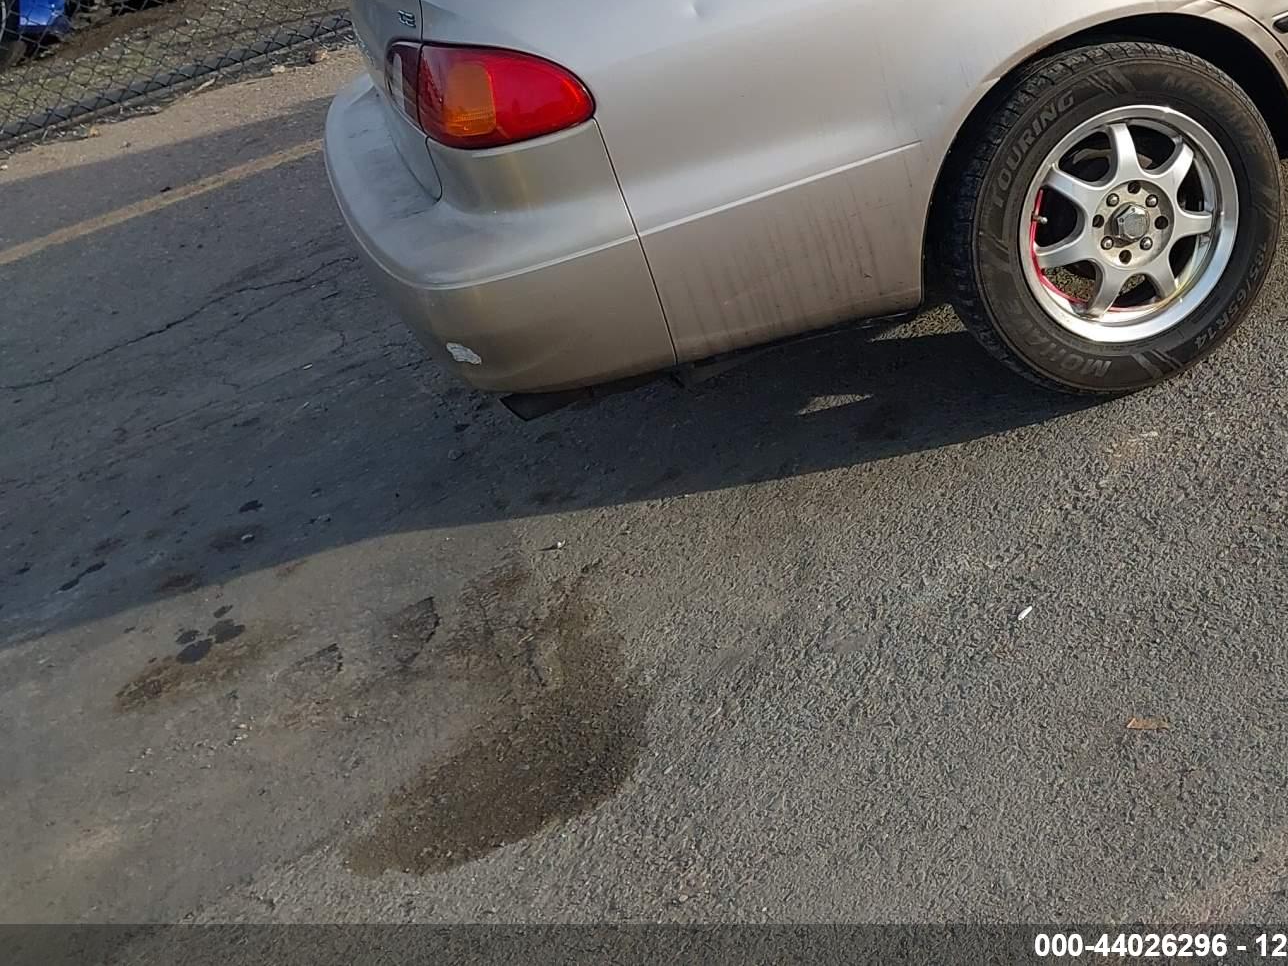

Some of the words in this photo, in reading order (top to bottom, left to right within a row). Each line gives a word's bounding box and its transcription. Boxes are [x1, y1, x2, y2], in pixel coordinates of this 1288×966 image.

[990, 88, 1076, 210] TOURING
[993, 298, 1113, 378] MOHAVE
[1194, 240, 1268, 350] 185/65R14
